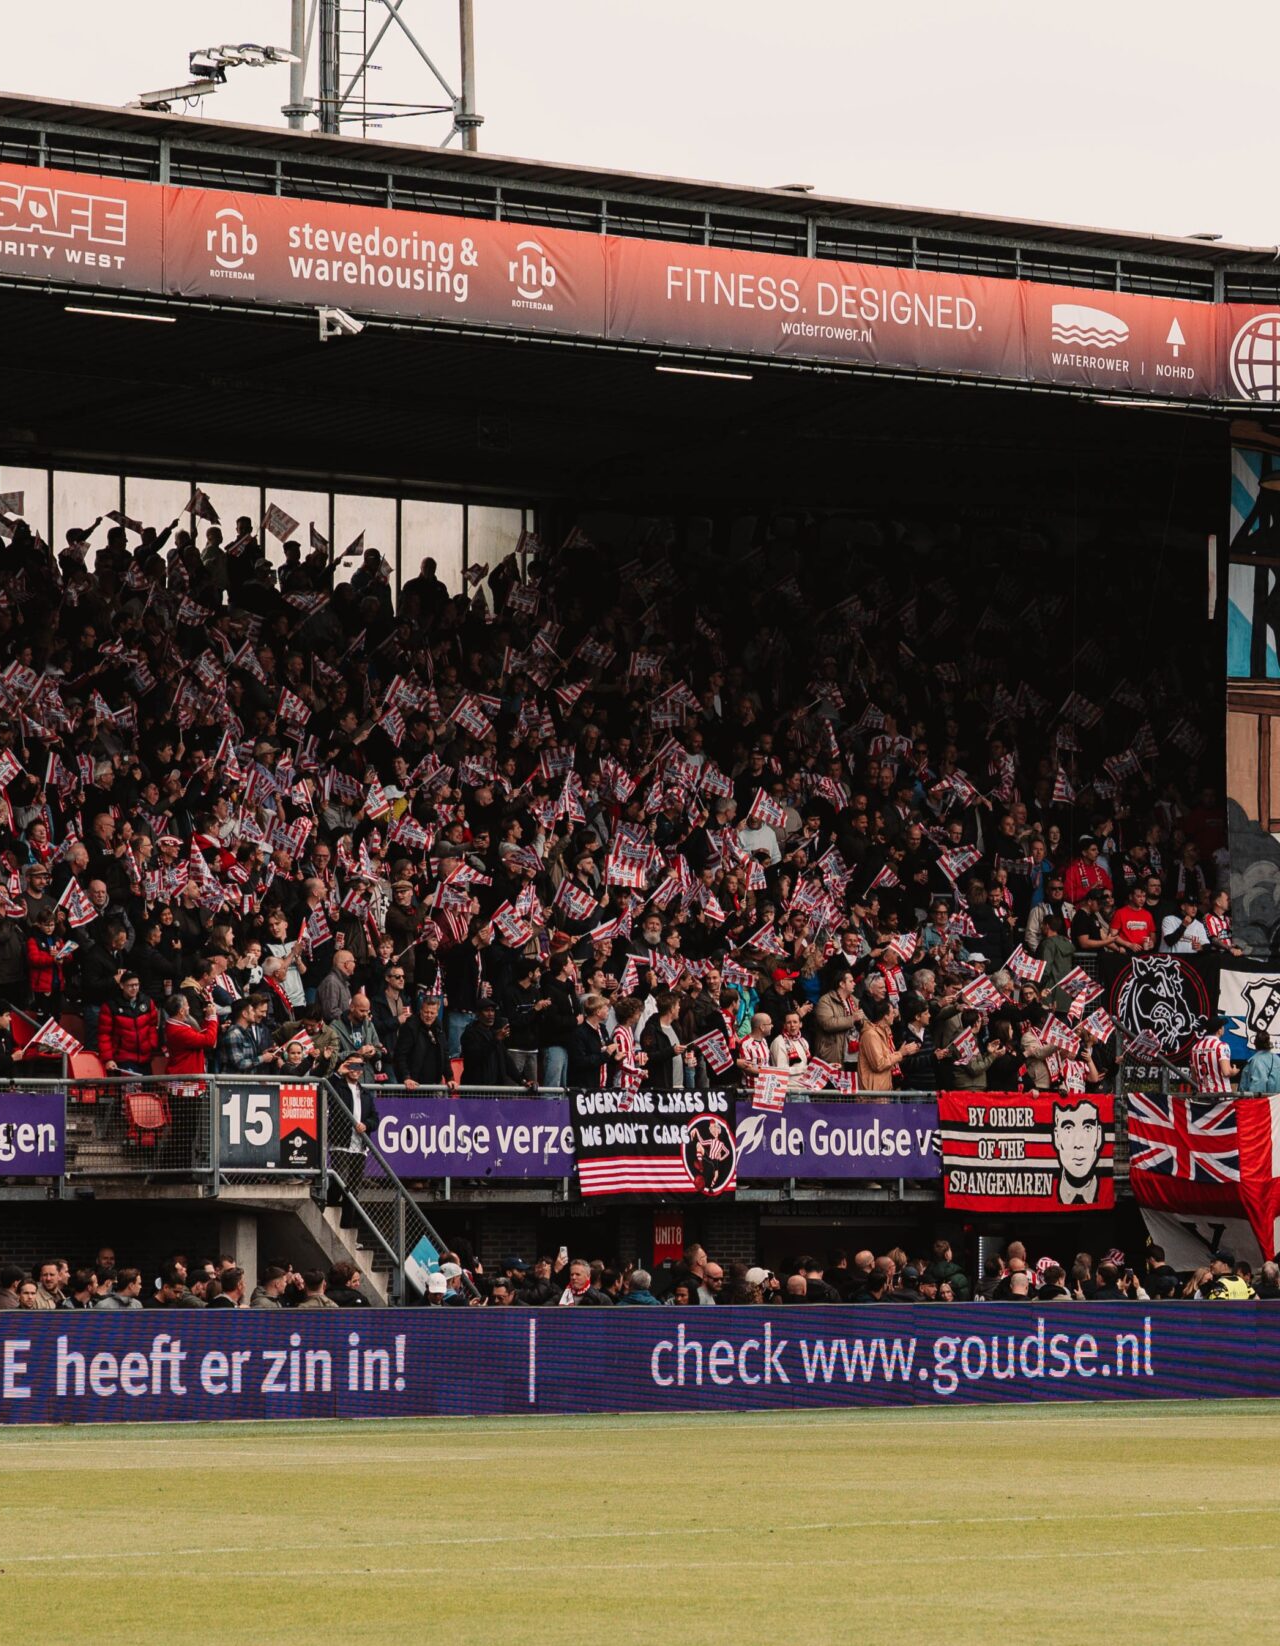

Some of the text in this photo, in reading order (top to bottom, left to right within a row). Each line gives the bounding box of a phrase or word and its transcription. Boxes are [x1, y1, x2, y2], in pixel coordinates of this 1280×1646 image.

[206, 223, 258, 257] rhb
[288, 222, 479, 272] stevedoring &
[65, 249, 126, 270] WEST
[508, 248, 557, 288] rhb
[209, 269, 256, 282] ROTTERDAM
[289, 252, 469, 303] warehousing
[511, 300, 554, 312] ROTTERDAM
[666, 265, 983, 332] FITNESS. DESIGNED.
[780, 318, 873, 344] waterrower.nl
[1051, 352, 1195, 380] WATERROWER NOHRD
[576, 1091, 728, 1116] EVERYNE LIKES US
[968, 1106, 1035, 1128] BY ORDER
[222, 1094, 273, 1146] 15
[377, 1114, 490, 1155] Goudse
[580, 1122, 691, 1148] WE DON'T CARE
[770, 1120, 804, 1156] de
[809, 1118, 911, 1156] Goudse
[978, 1138, 1026, 1160] OF THE
[949, 1170, 1054, 1197] SPANGENAREN
[655, 1226, 683, 1246] UNIT8
[56, 1333, 187, 1398] heeft
[201, 1350, 251, 1395] er
[261, 1332, 331, 1394] zin
[349, 1332, 406, 1393] in!
[651, 1316, 1155, 1395] check www.goudse.nl
